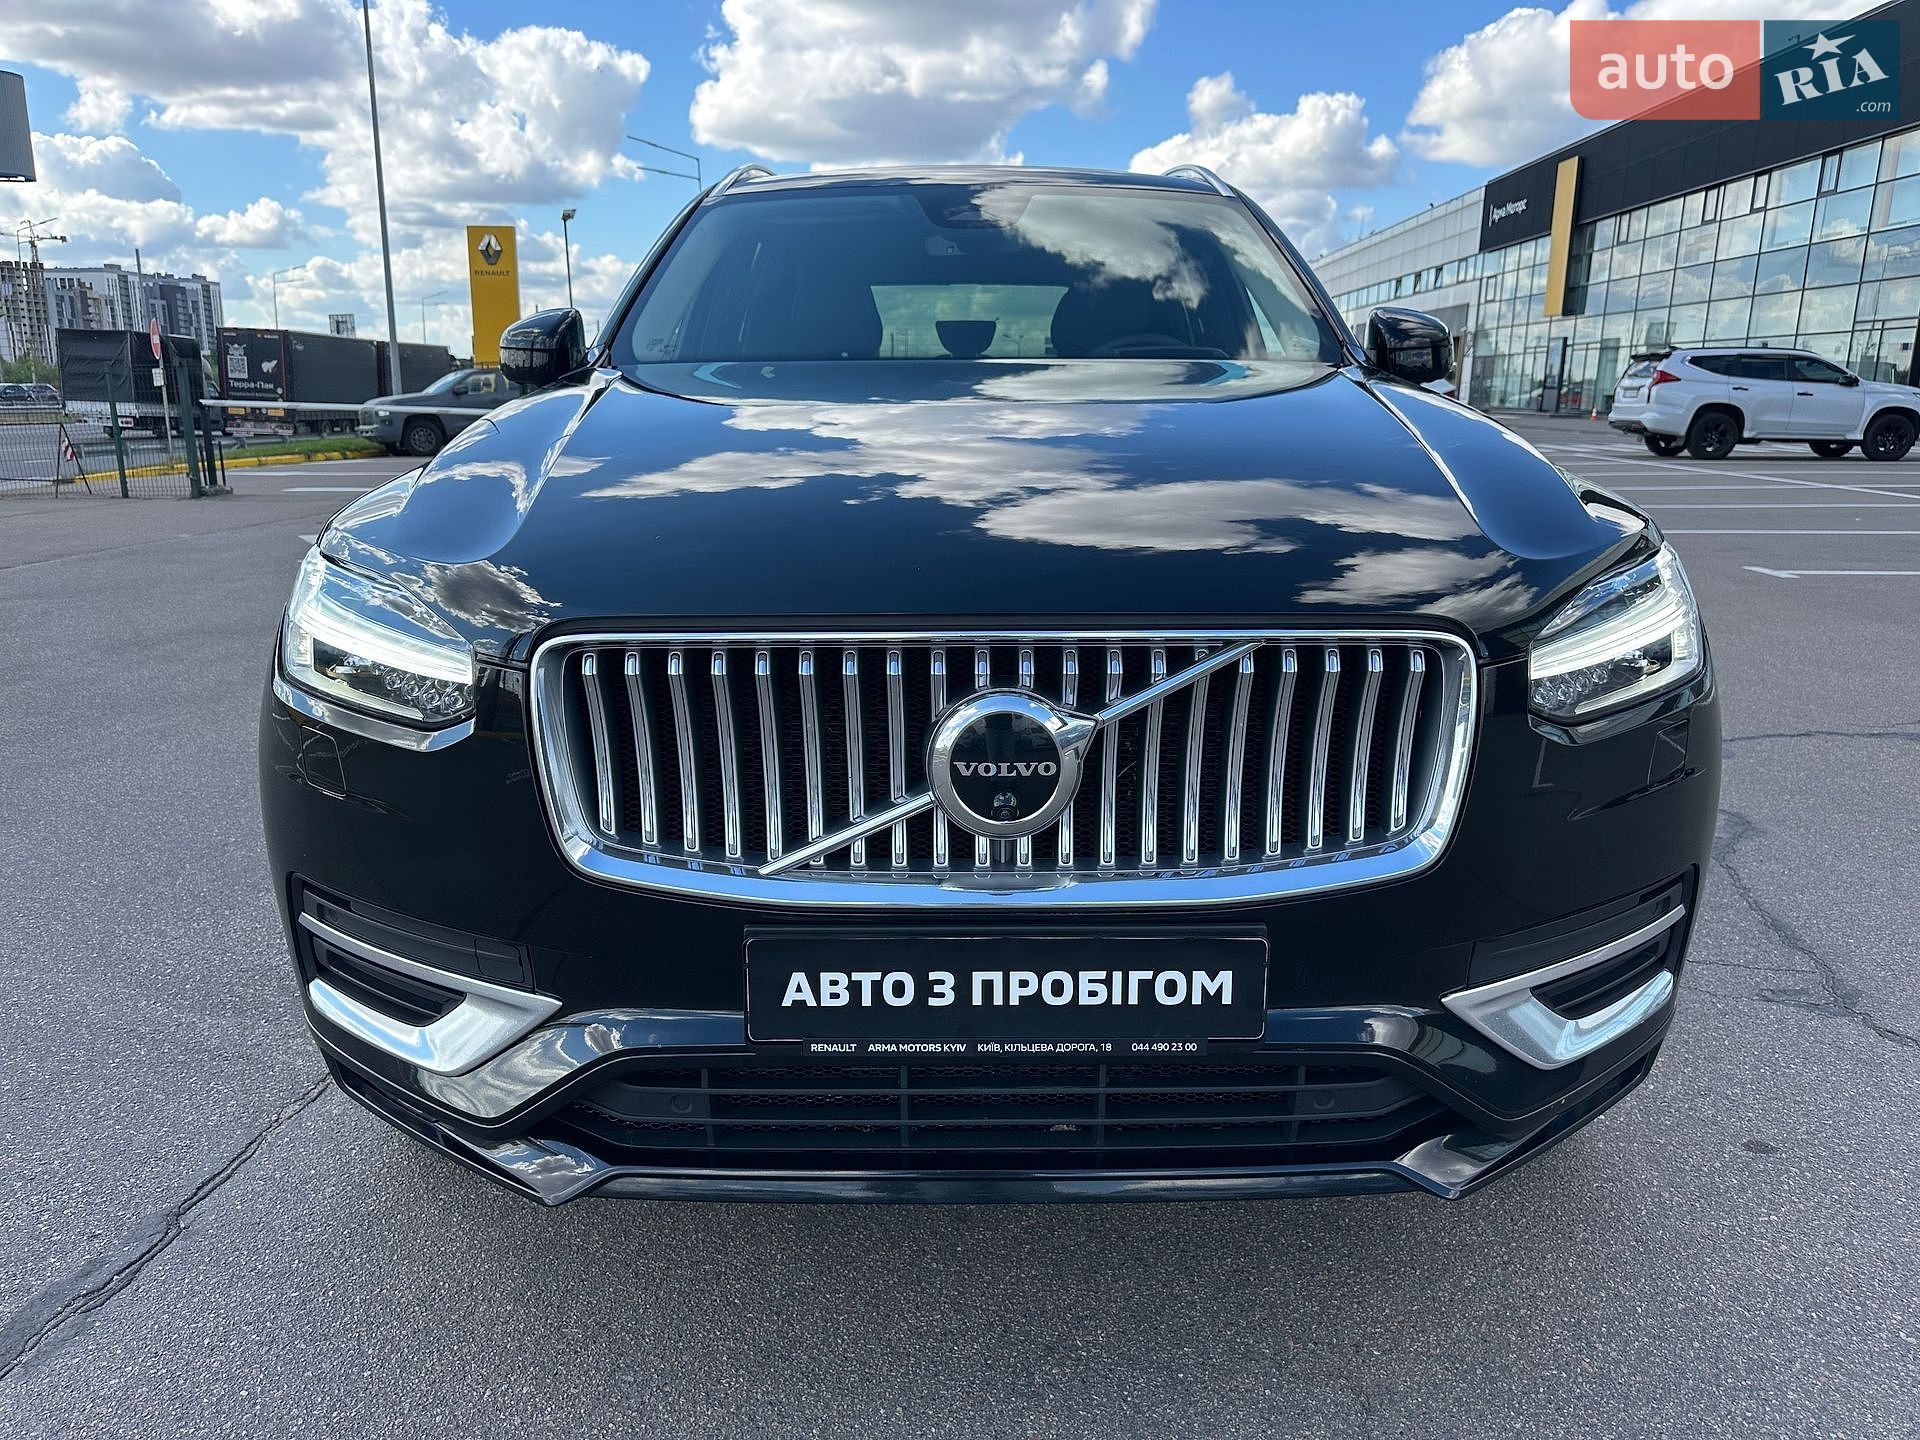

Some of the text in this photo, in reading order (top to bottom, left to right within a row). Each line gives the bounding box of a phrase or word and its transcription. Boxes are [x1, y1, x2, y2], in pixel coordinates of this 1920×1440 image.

[953, 761, 1057, 777] VOLVO
[781, 971, 915, 1007] АВТО
[971, 970, 1233, 1006] ПРОБІГОМ
[810, 1043, 967, 1052] RENAULT ARMA MOTORS KYIV
[977, 1042, 1112, 1053] КИЇВ, КІЛЬЦЕВА ДОРОГА, 18
[1132, 1042, 1198, 1051] 044 490 23 00
